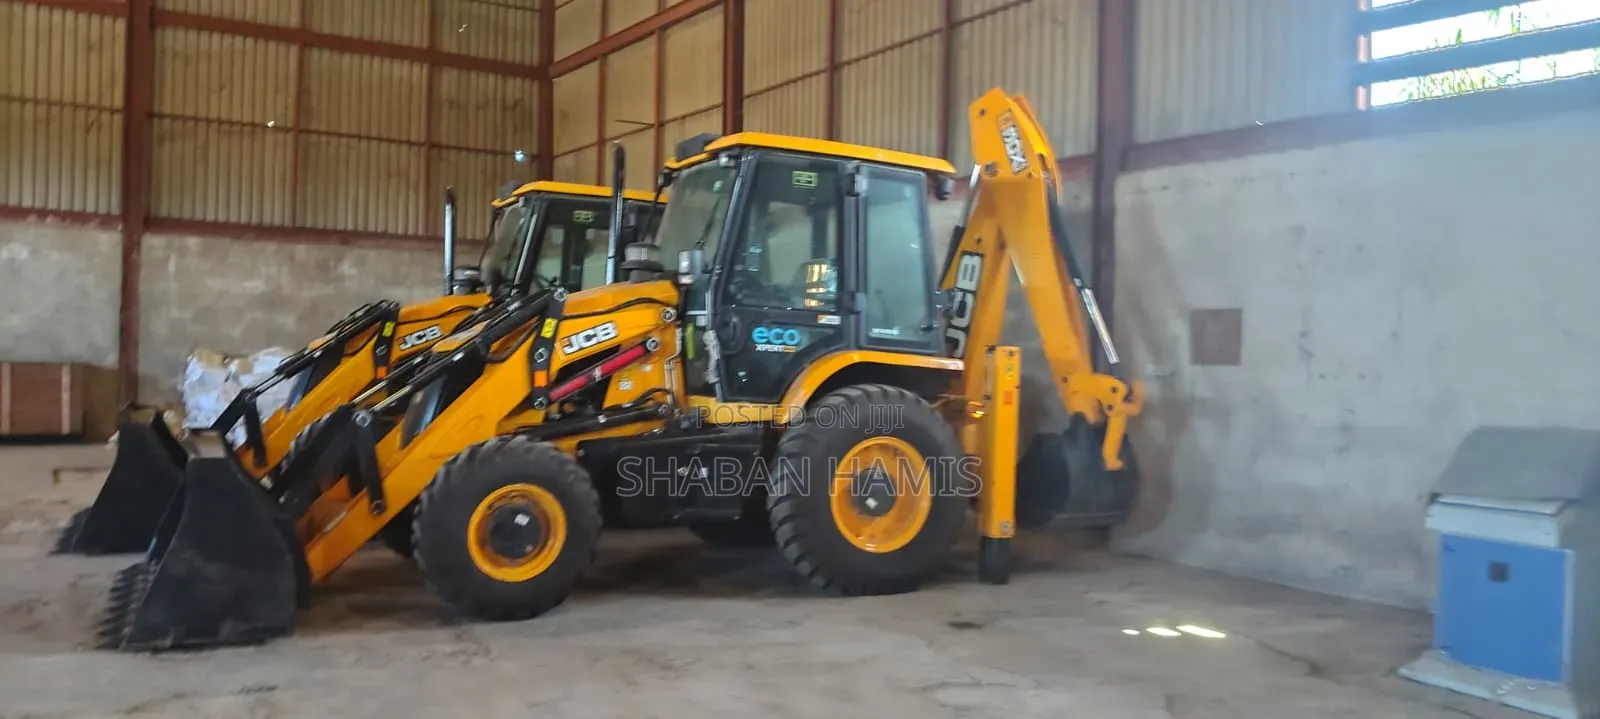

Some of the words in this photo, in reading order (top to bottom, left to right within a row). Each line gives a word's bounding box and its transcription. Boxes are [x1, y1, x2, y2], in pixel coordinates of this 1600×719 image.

[946, 253, 983, 358] JCB
[400, 325, 442, 350] JCB
[563, 321, 618, 355] JCB
[752, 326, 801, 346] eco
